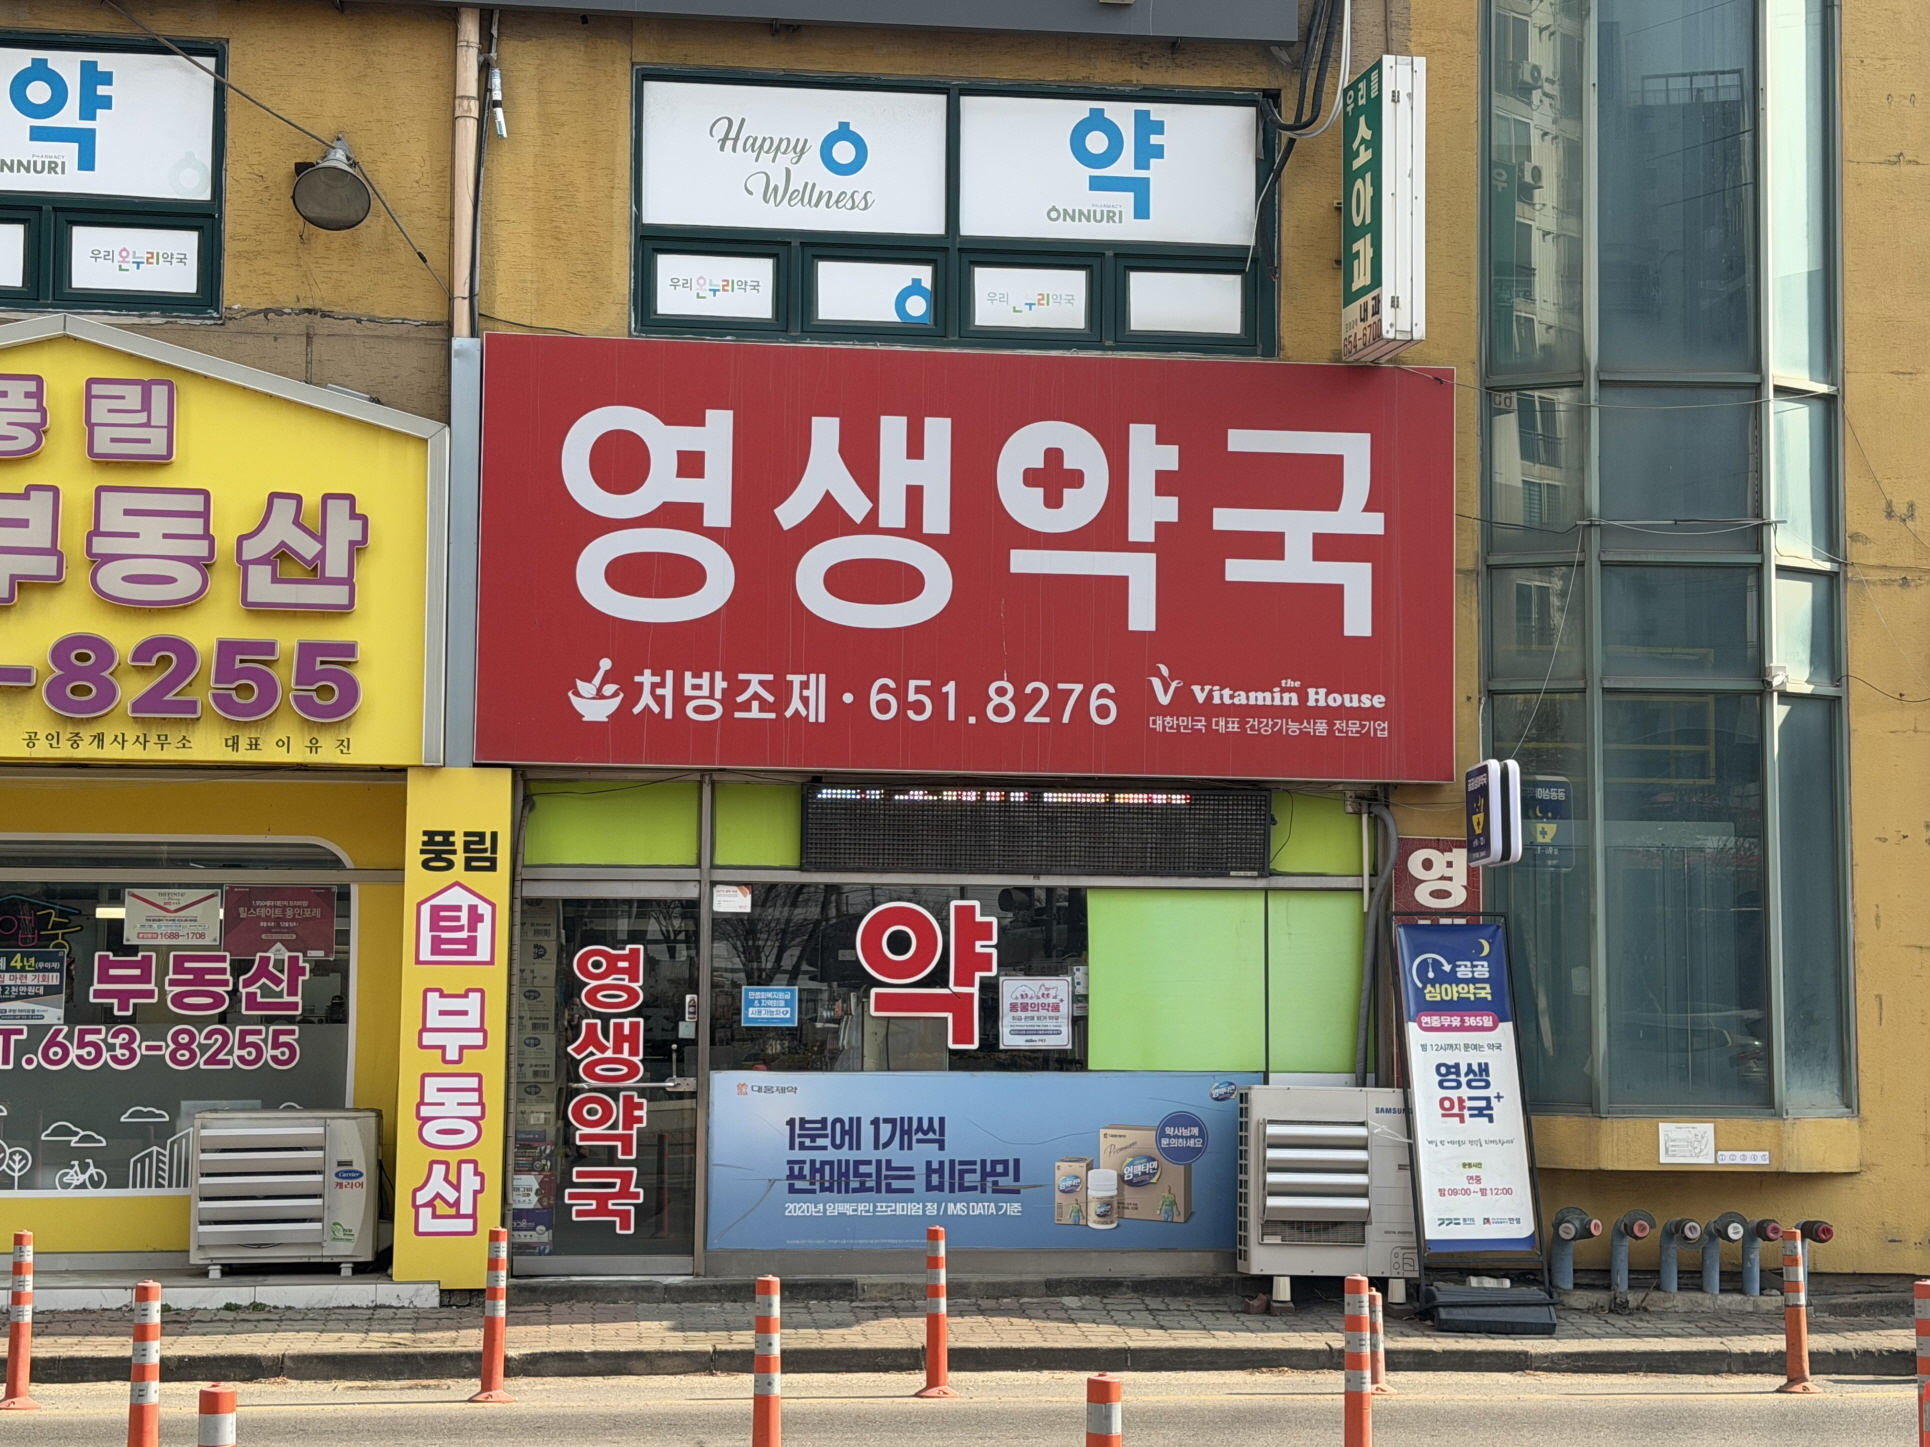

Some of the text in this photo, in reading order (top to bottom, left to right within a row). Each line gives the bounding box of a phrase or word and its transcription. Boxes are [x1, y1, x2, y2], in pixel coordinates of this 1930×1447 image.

[1346, 68, 1379, 117] 우리들
[9, 57, 114, 172] 약
[708, 115, 812, 165] Happy
[1069, 107, 1165, 220] 약
[743, 168, 876, 213] Wellness
[1351, 113, 1374, 293] 소아과
[1343, 317, 1382, 357] 654-6700
[560, 404, 1386, 637] 영생약국
[631, 668, 1119, 726] 처방조제 651.8276
[1190, 684, 1387, 709] Vitamin House
[1280, 678, 1302, 688] the
[21, 730, 194, 752] 공인중개사사무소
[223, 735, 264, 753] 대표
[1149, 715, 1389, 738] 대한민국 대표 건강기능식품 전문기업
[418, 829, 499, 873] 풍림
[1407, 847, 1468, 925] 영
[159, 931, 206, 940] 1688-1708
[428, 903, 485, 957] 탑
[89, 951, 310, 1016] 부동산
[856, 900, 998, 1049] 약
[1455, 961, 1490, 979] 공공
[1423, 983, 1492, 1001] 심야약국
[1421, 1015, 1494, 1028] 연중무휴 365일
[1430, 1043, 1462, 1052] 12시까지
[1487, 1042, 1503, 1052] 약국
[564, 943, 648, 1235] 영생약국
[751, 1084, 799, 1095] 대웅제약
[1435, 1062, 1492, 1091] 영생
[411, 987, 489, 1237] 부동산
[1438, 1095, 1495, 1125] 약국
[785, 1116, 947, 1152] 1분에 1개씩
[1161, 1138, 1204, 1149] 문의하세요
[1165, 1126, 1200, 1137] 약사님께
[334, 1181, 364, 1190] 캐리어
[785, 1158, 1022, 1195] 판매되는 비타민
[1447, 1187, 1472, 1197] 09:00
[1489, 1187, 1514, 1196] 12:00
[1466, 1175, 1482, 1185] 연중
[784, 1202, 824, 1217] 2020년
[825, 1202, 875, 1217] 임팩타민
[875, 1202, 923, 1217] 프리미엄
[925, 1202, 939, 1216] 정
[947, 1202, 968, 1216] IMS
[969, 1202, 997, 1216] DATA
[998, 1203, 1023, 1217] 기준
